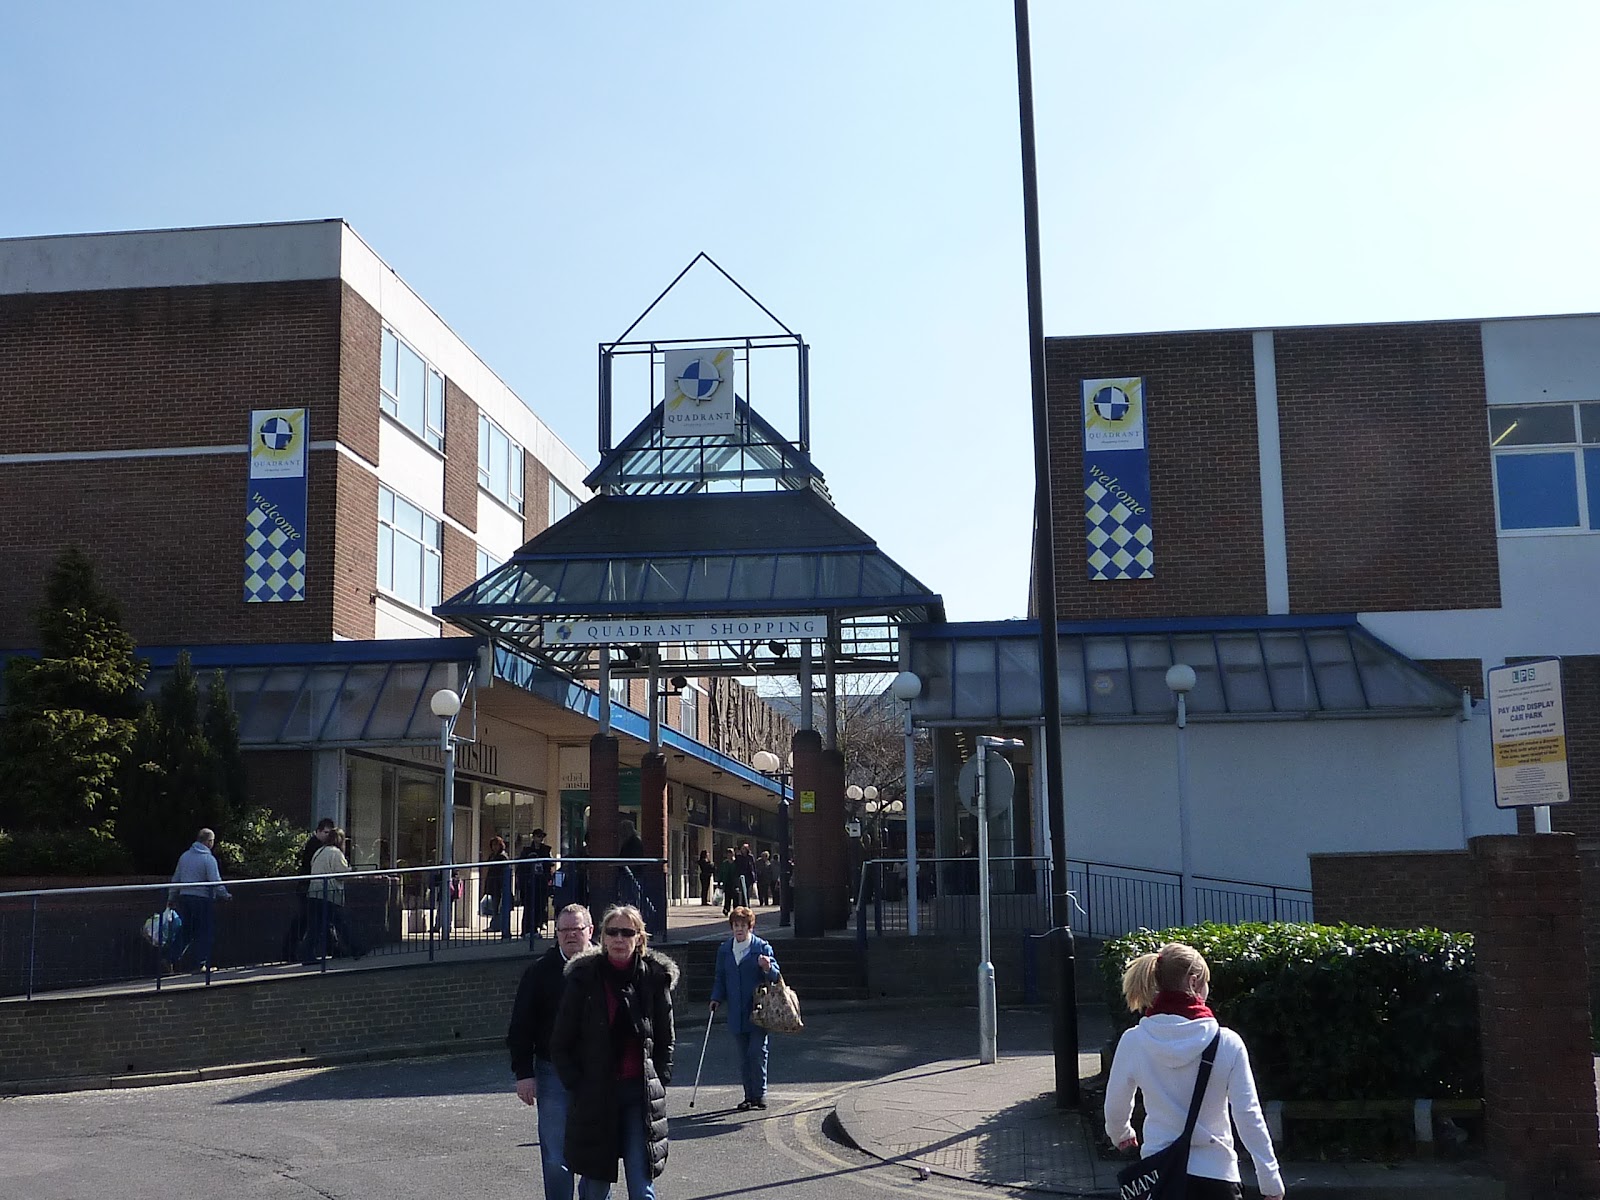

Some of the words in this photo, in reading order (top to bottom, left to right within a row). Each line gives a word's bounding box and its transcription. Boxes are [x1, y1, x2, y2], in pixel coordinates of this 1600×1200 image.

[668, 412, 731, 423] QUADRANT
[1089, 431, 1140, 440] QUADRANT
[254, 460, 301, 468] QUADRANT
[1089, 464, 1147, 516] welcome
[252, 492, 301, 541] welcome
[587, 624, 696, 639] QUADRANT
[710, 620, 816, 635] SHOPPING
[1512, 668, 1535, 683] LPS
[1511, 704, 1526, 712] AND
[1526, 700, 1554, 710] DISPLAY
[1525, 711, 1543, 720] PARK
